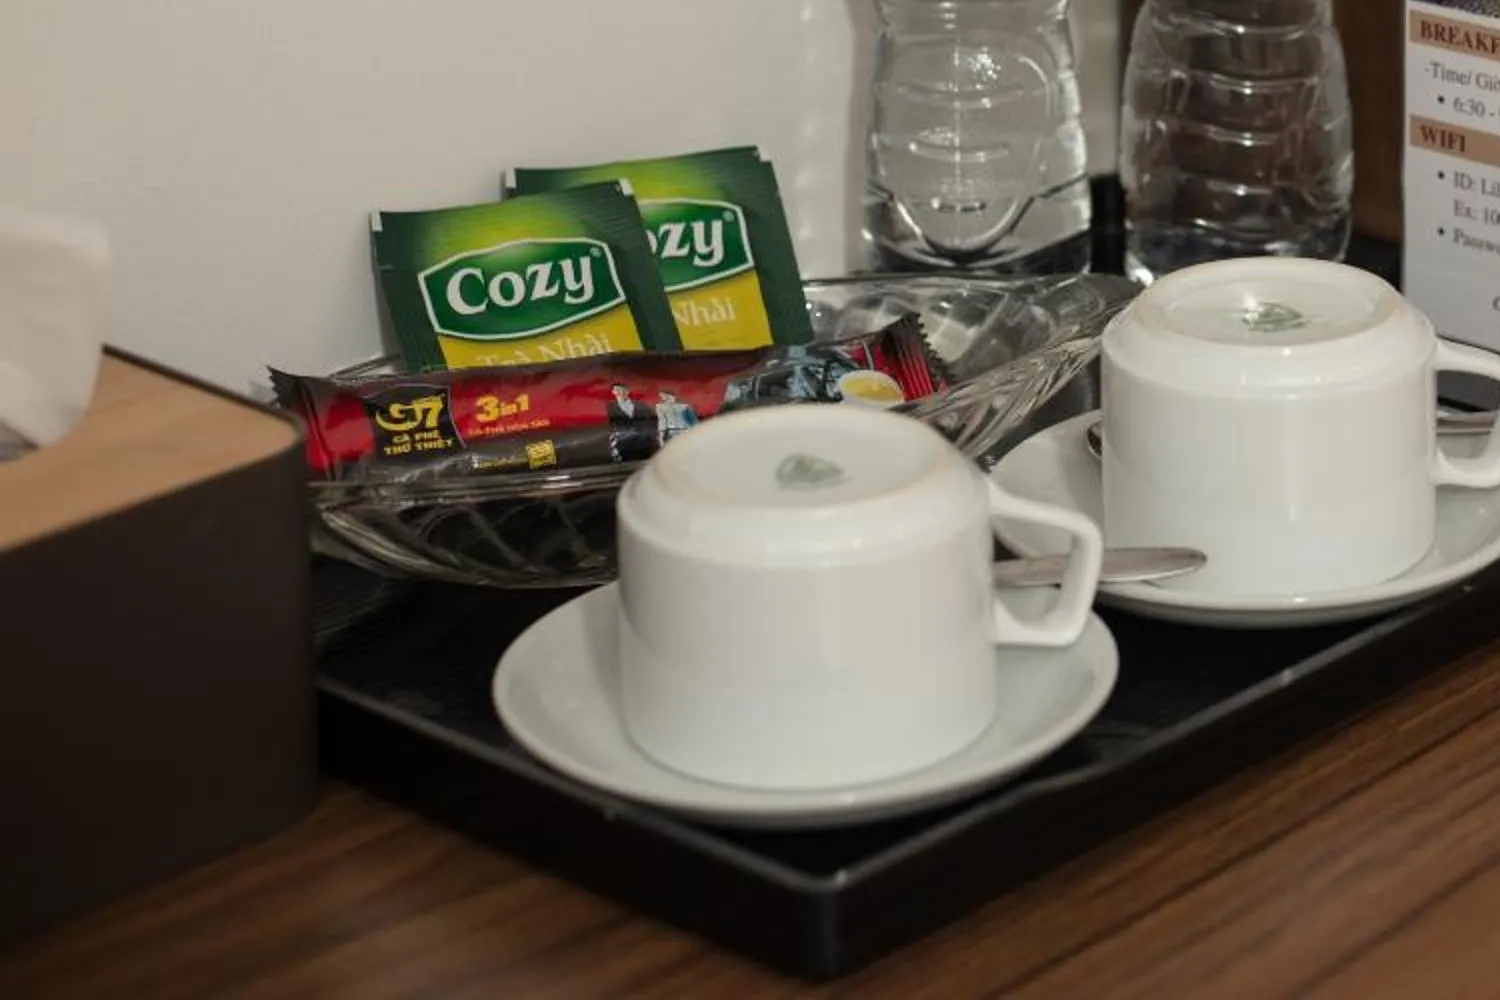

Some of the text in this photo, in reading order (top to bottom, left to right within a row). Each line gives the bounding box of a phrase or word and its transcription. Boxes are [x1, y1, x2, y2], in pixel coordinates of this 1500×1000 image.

[1453, 95, 1485, 120] 6:30
[1420, 124, 1467, 154] WIFI
[1453, 170, 1475, 193] ID:
[645, 218, 725, 268] zy
[445, 254, 595, 316] Cozy
[474, 393, 530, 423] 3in1
